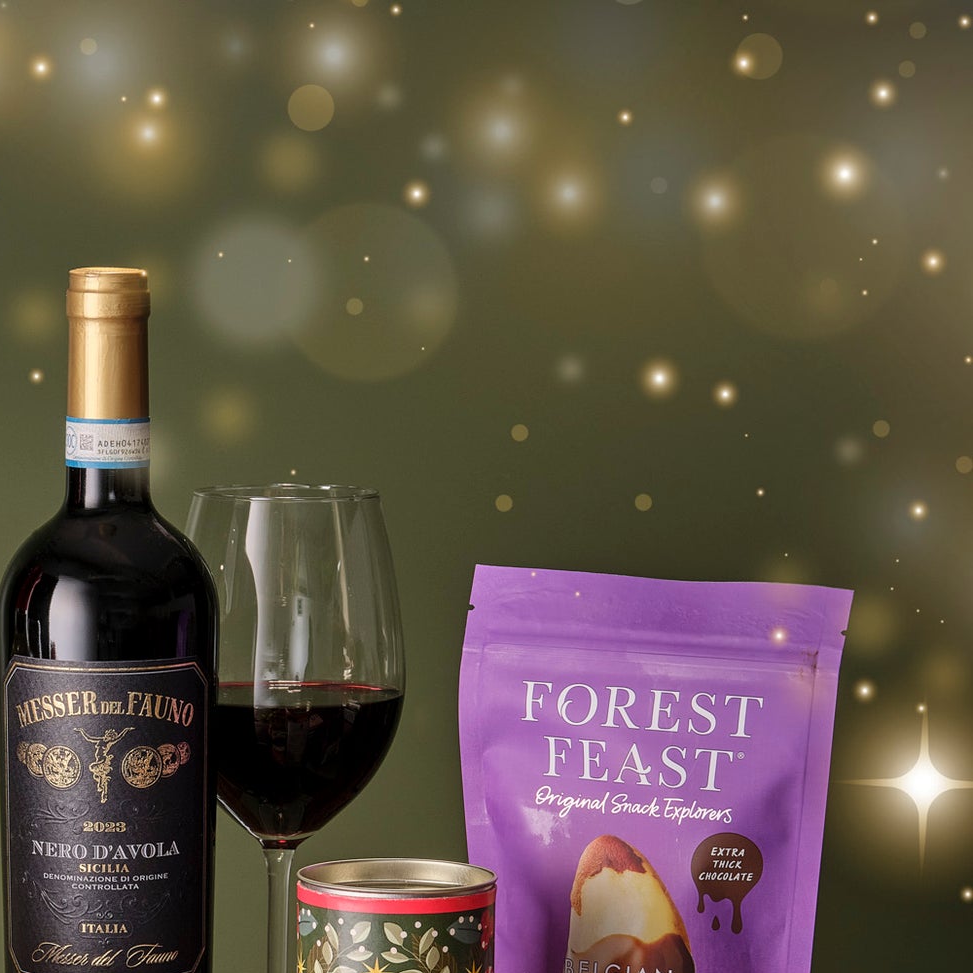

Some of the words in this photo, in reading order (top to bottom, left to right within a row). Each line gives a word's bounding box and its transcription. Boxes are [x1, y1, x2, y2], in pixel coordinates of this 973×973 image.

[16, 691, 100, 728] MESSER
[100, 701, 126, 715] DEL
[127, 691, 194, 728] FAUNO
[520, 680, 764, 738] FOREST
[543, 736, 734, 792] FEAST
[535, 785, 610, 818] Original
[611, 794, 661, 818] Snack
[663, 798, 733, 825] Explorers
[82, 821, 127, 833] 2023
[31, 840, 88, 860] NERO
[710, 847, 745, 857] EXTRA
[79, 863, 130, 873] SICILIA
[712, 860, 742, 869] THICK
[43, 872, 118, 883] DENOMINAZIONE
[132, 872, 169, 882] ORIGINE
[698, 872, 753, 882] CHOCOLATE
[71, 882, 140, 890] CONTROLLATA
[80, 923, 128, 934] ITALIA
[31, 942, 89, 966] Messer
[91, 943, 123, 968] del
[126, 942, 179, 968] Fauno
